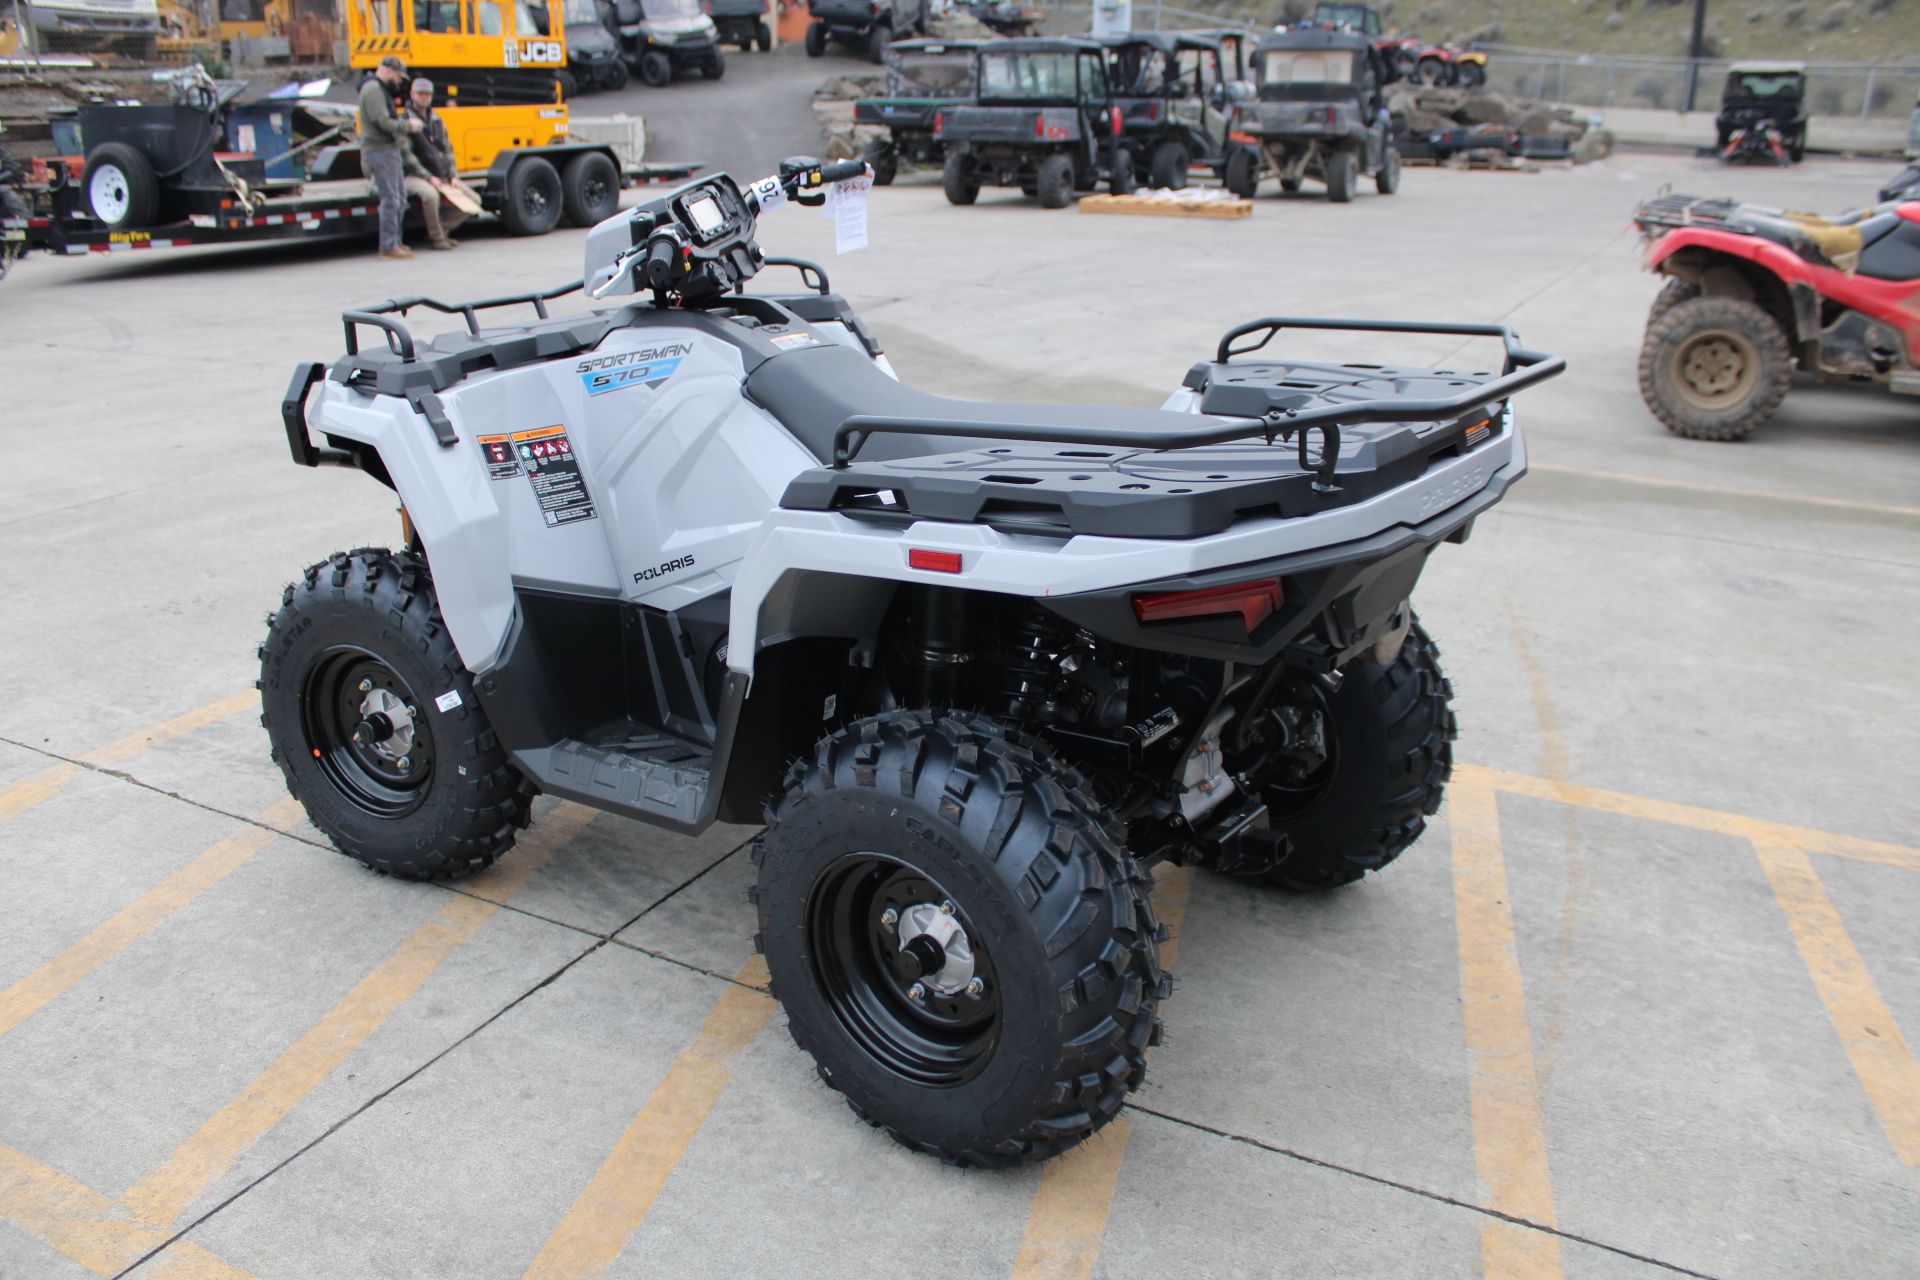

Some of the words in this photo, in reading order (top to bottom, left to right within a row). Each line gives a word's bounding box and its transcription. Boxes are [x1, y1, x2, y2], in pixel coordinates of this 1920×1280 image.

[519, 41, 562, 63] JCB
[759, 181, 779, 203] 26
[576, 341, 694, 374] SPORTSMAN
[592, 365, 651, 388] 570
[1419, 466, 1484, 518] POLARIS
[633, 553, 696, 585] POLARIS
